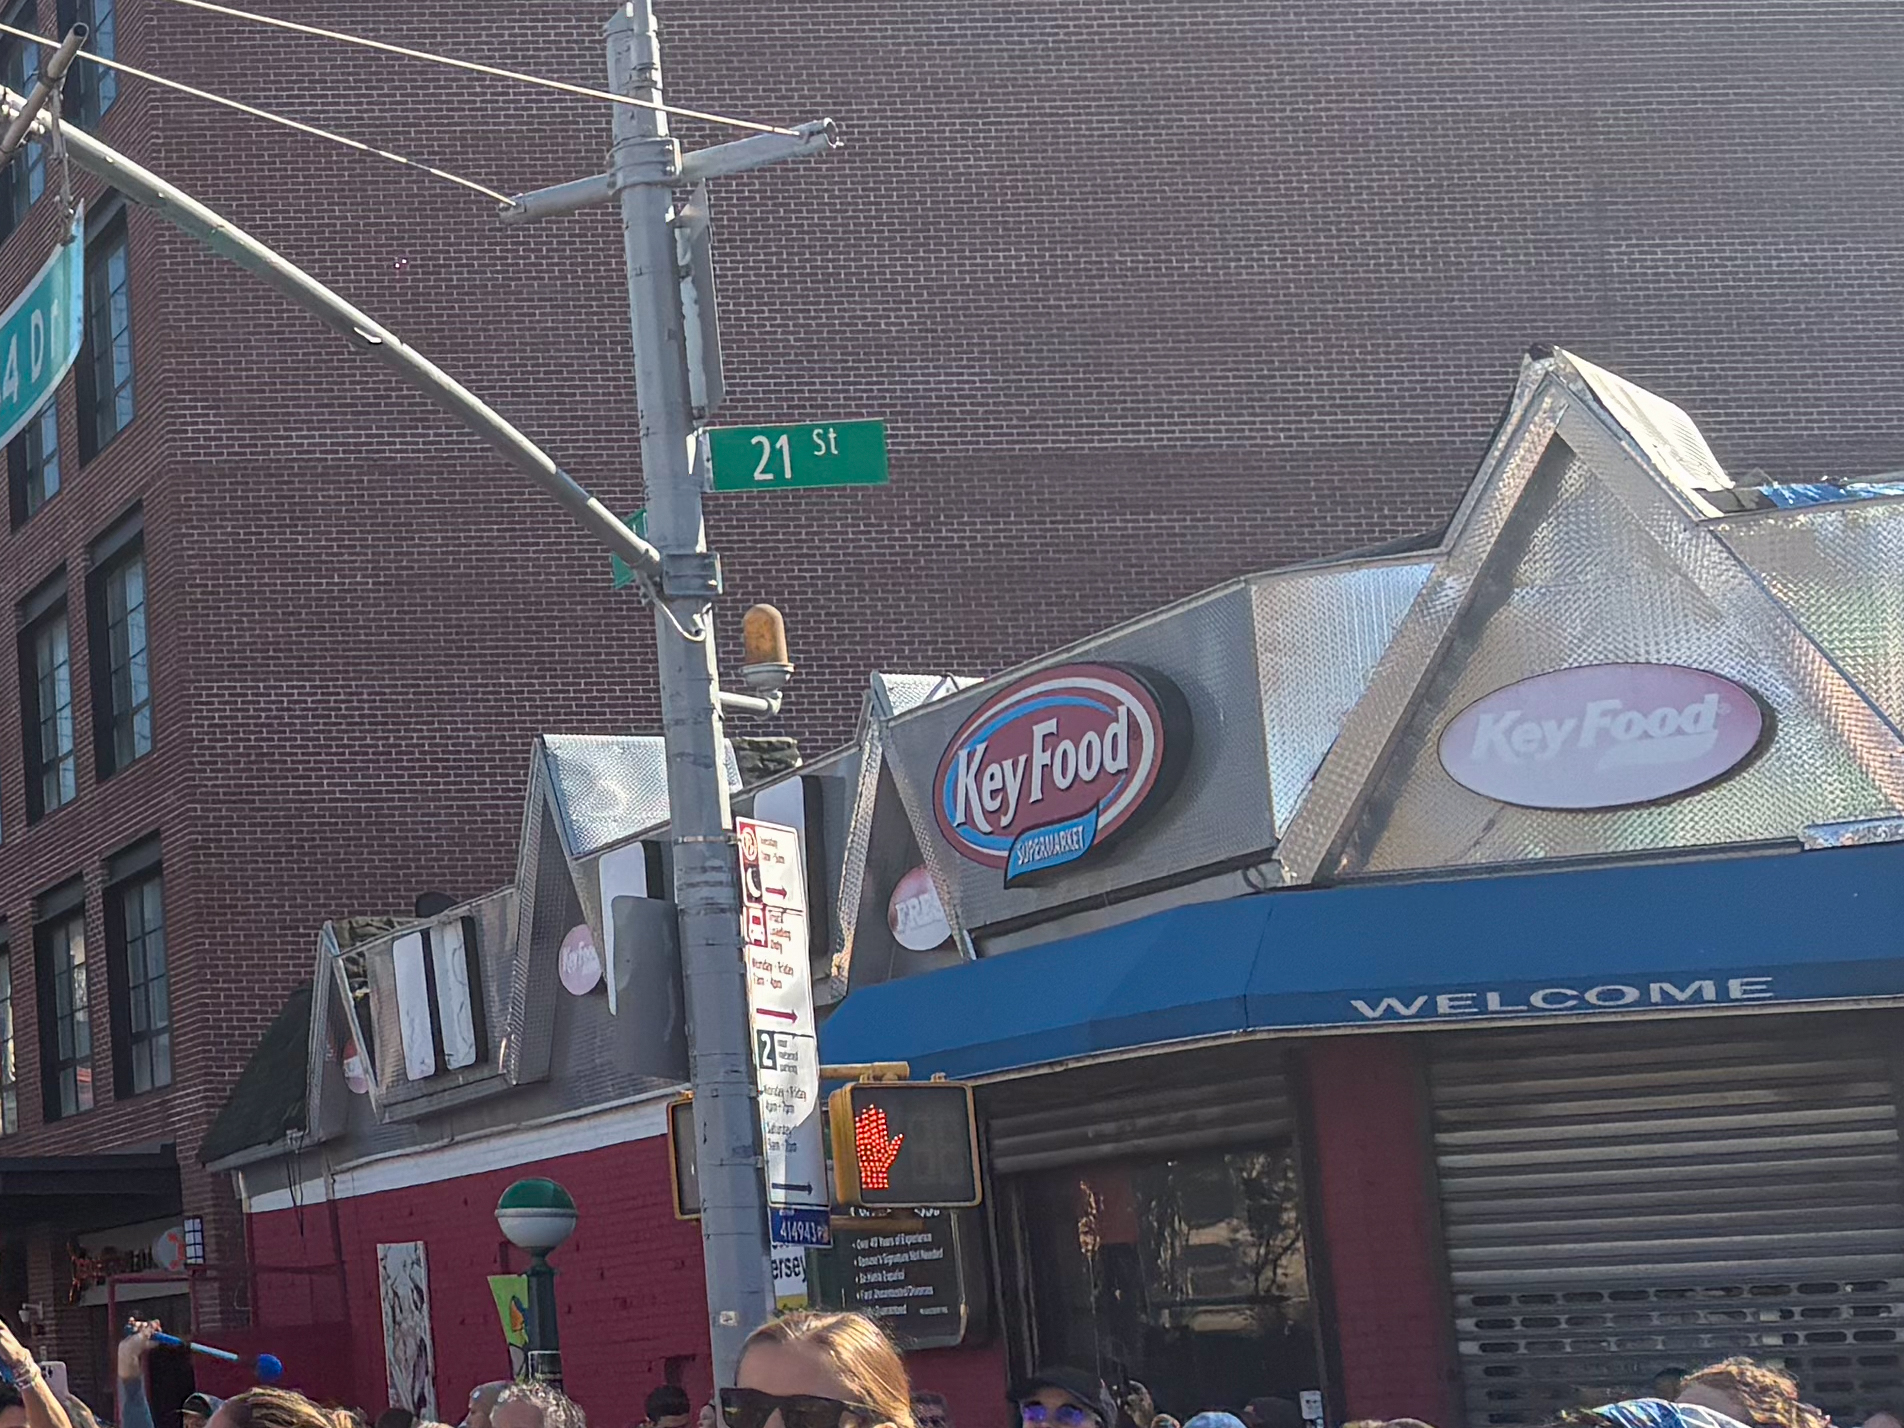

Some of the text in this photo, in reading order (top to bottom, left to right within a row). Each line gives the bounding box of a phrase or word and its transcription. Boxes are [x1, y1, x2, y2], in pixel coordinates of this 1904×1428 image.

[751, 434, 792, 481] 21
[1470, 693, 1720, 768] Key Food
[953, 704, 1129, 834] Key Food
[1016, 825, 1085, 866] SUPERMARKET
[1348, 975, 1775, 1021] WELCOME
[760, 1032, 773, 1067] 2
